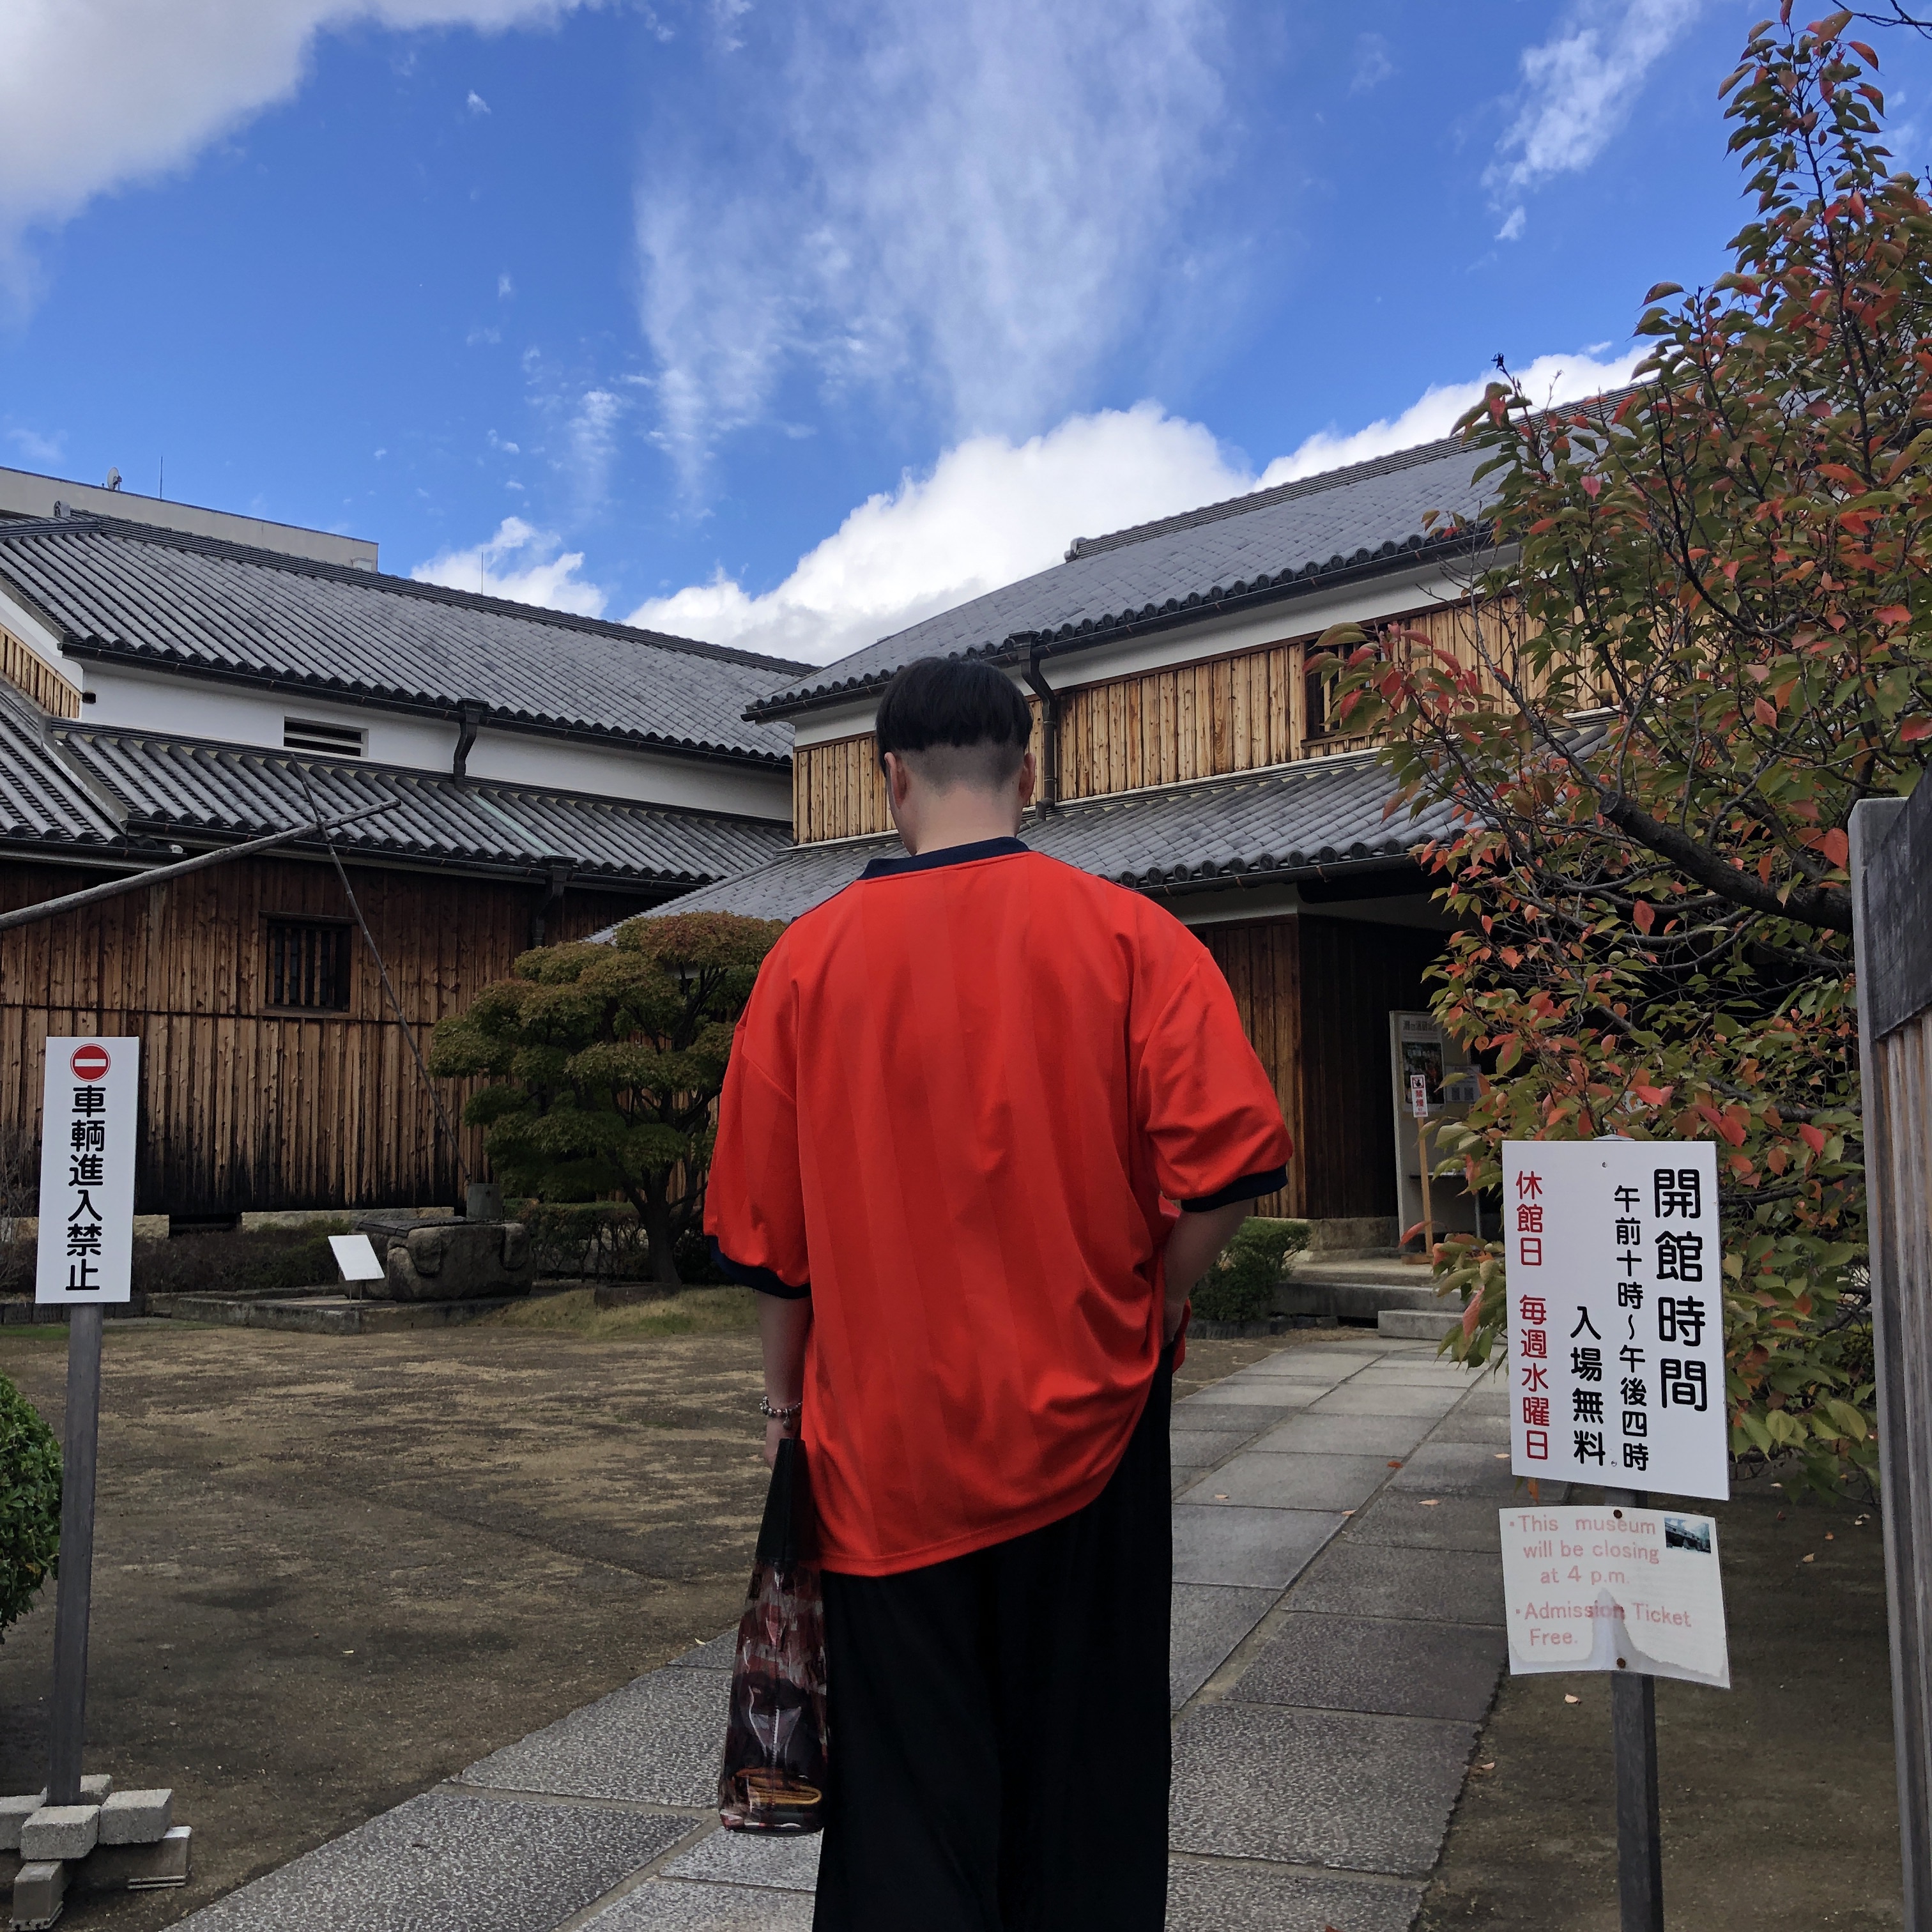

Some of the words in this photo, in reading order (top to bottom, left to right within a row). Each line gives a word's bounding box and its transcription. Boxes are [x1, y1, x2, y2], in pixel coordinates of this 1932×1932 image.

[65, 1085, 106, 1291] 車輌進入禁止
[1515, 1170, 1542, 1266] 休館日
[1653, 1169, 1707, 1411] 開館時間
[1519, 1294, 1550, 1459] 毎週水曜日
[1570, 1306, 1605, 1466] 入場無料
[1518, 1514, 1558, 1532] This
[1575, 1517, 1656, 1534] museum
[1523, 1540, 1552, 1558] will
[1560, 1540, 1583, 1557] be
[1592, 1540, 1659, 1564] closing
[1524, 1600, 1625, 1620] Admission
[1632, 1602, 1692, 1627] Ticket
[1540, 1568, 1559, 1584] at
[1567, 1565, 1581, 1582] 4
